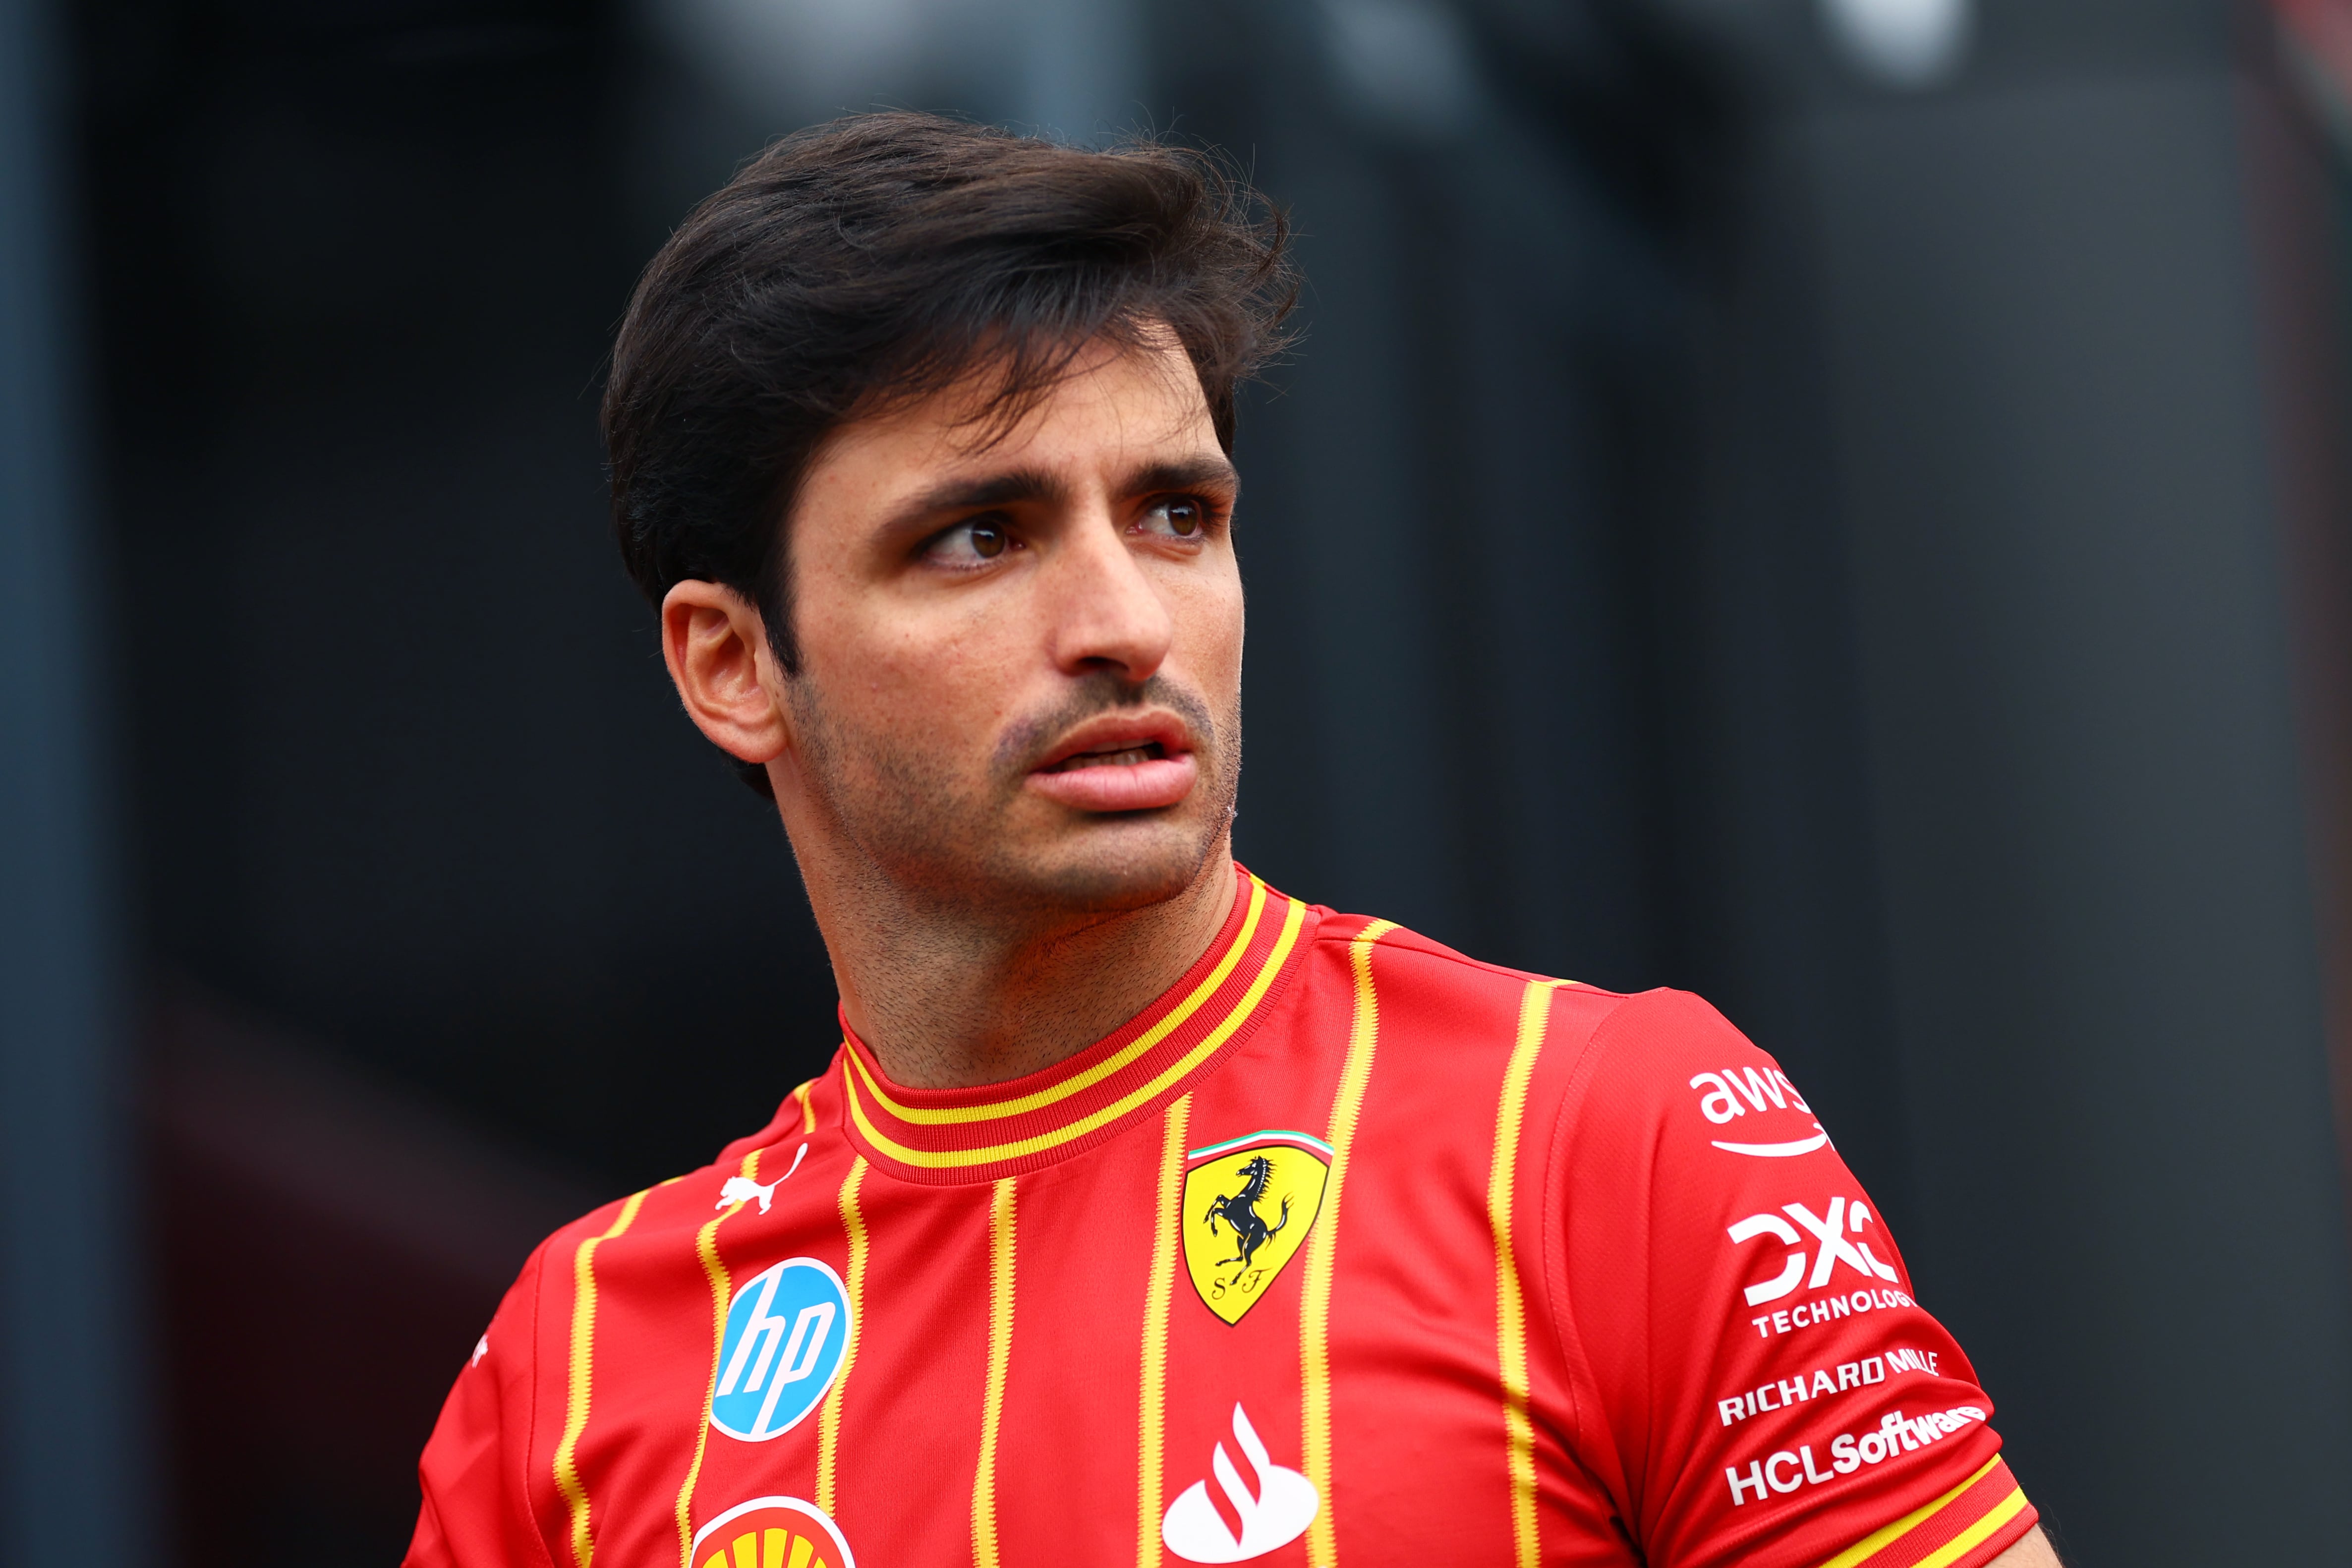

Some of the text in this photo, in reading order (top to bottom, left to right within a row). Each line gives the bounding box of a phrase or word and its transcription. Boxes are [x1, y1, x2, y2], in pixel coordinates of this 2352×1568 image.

[1689, 1067, 1812, 1124] aws
[1211, 1278, 1226, 1299] S
[715, 1269, 836, 1434] hp
[1718, 1348, 1940, 1426] RICHARD MILLE
